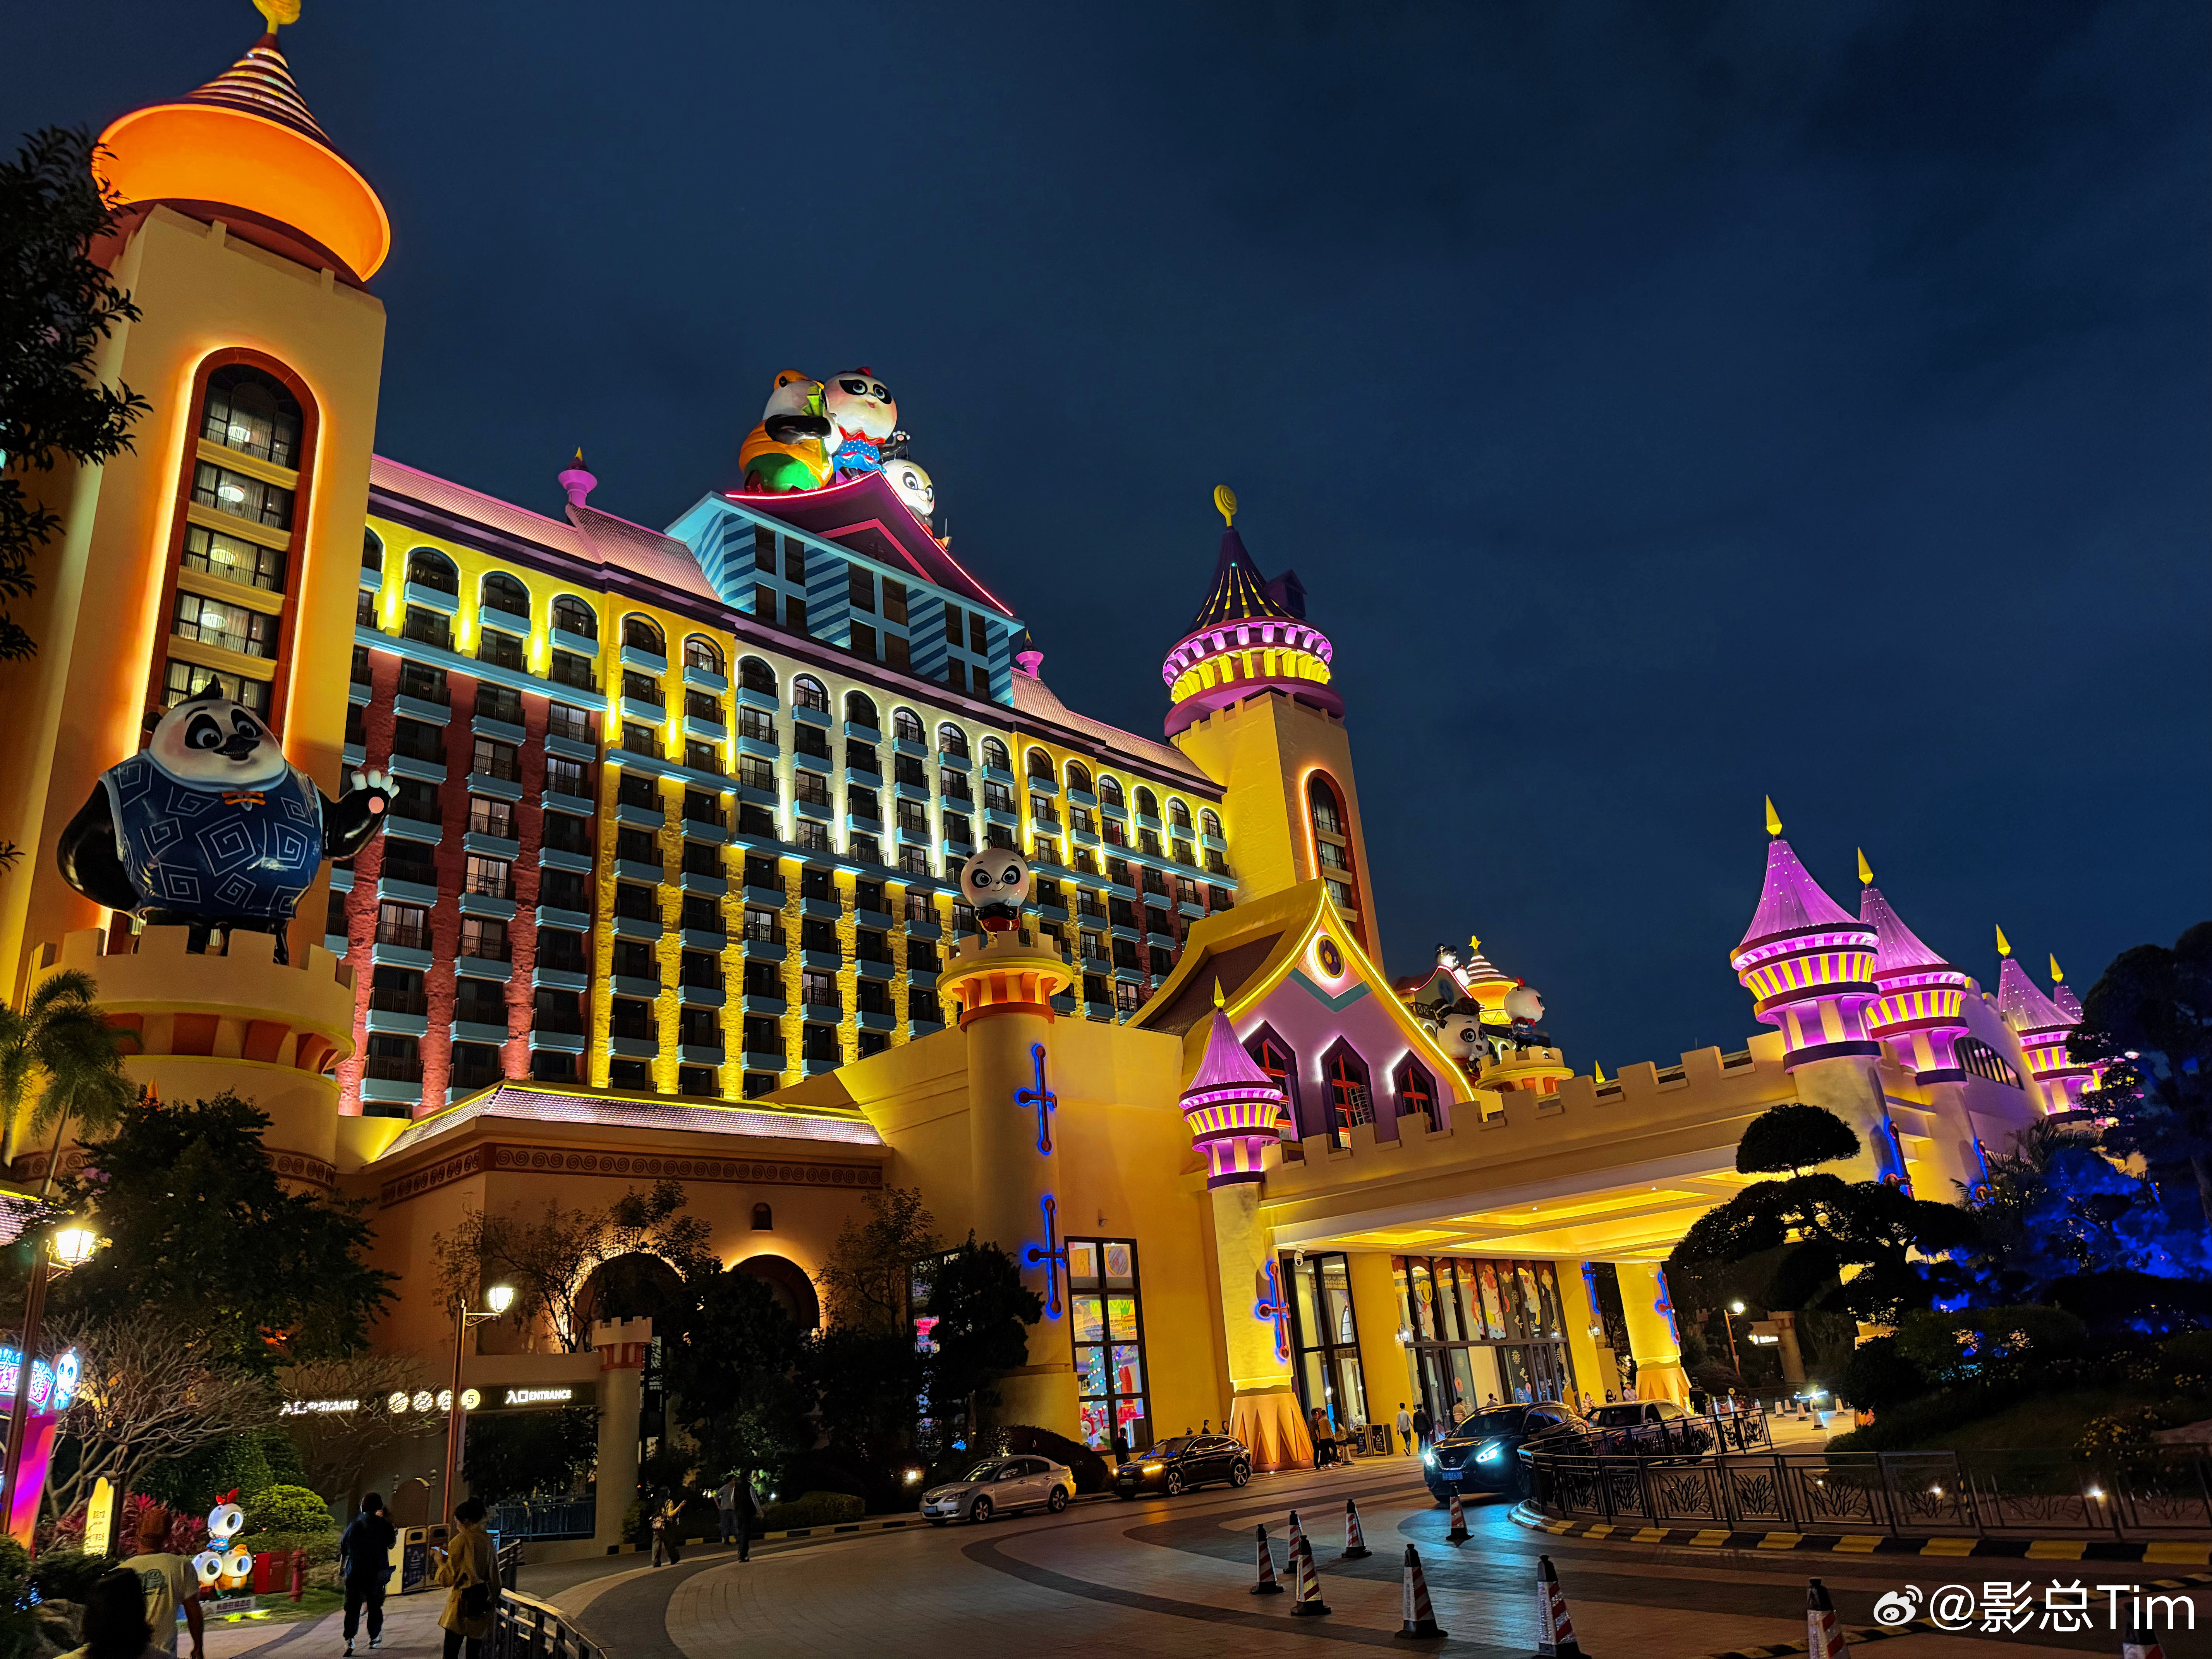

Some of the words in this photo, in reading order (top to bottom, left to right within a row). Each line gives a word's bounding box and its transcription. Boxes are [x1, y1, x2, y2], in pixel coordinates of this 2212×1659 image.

[467, 1395, 474, 1404] 5
[505, 1390, 529, 1404] 入口
[529, 1389, 572, 1401] ENTRANCE
